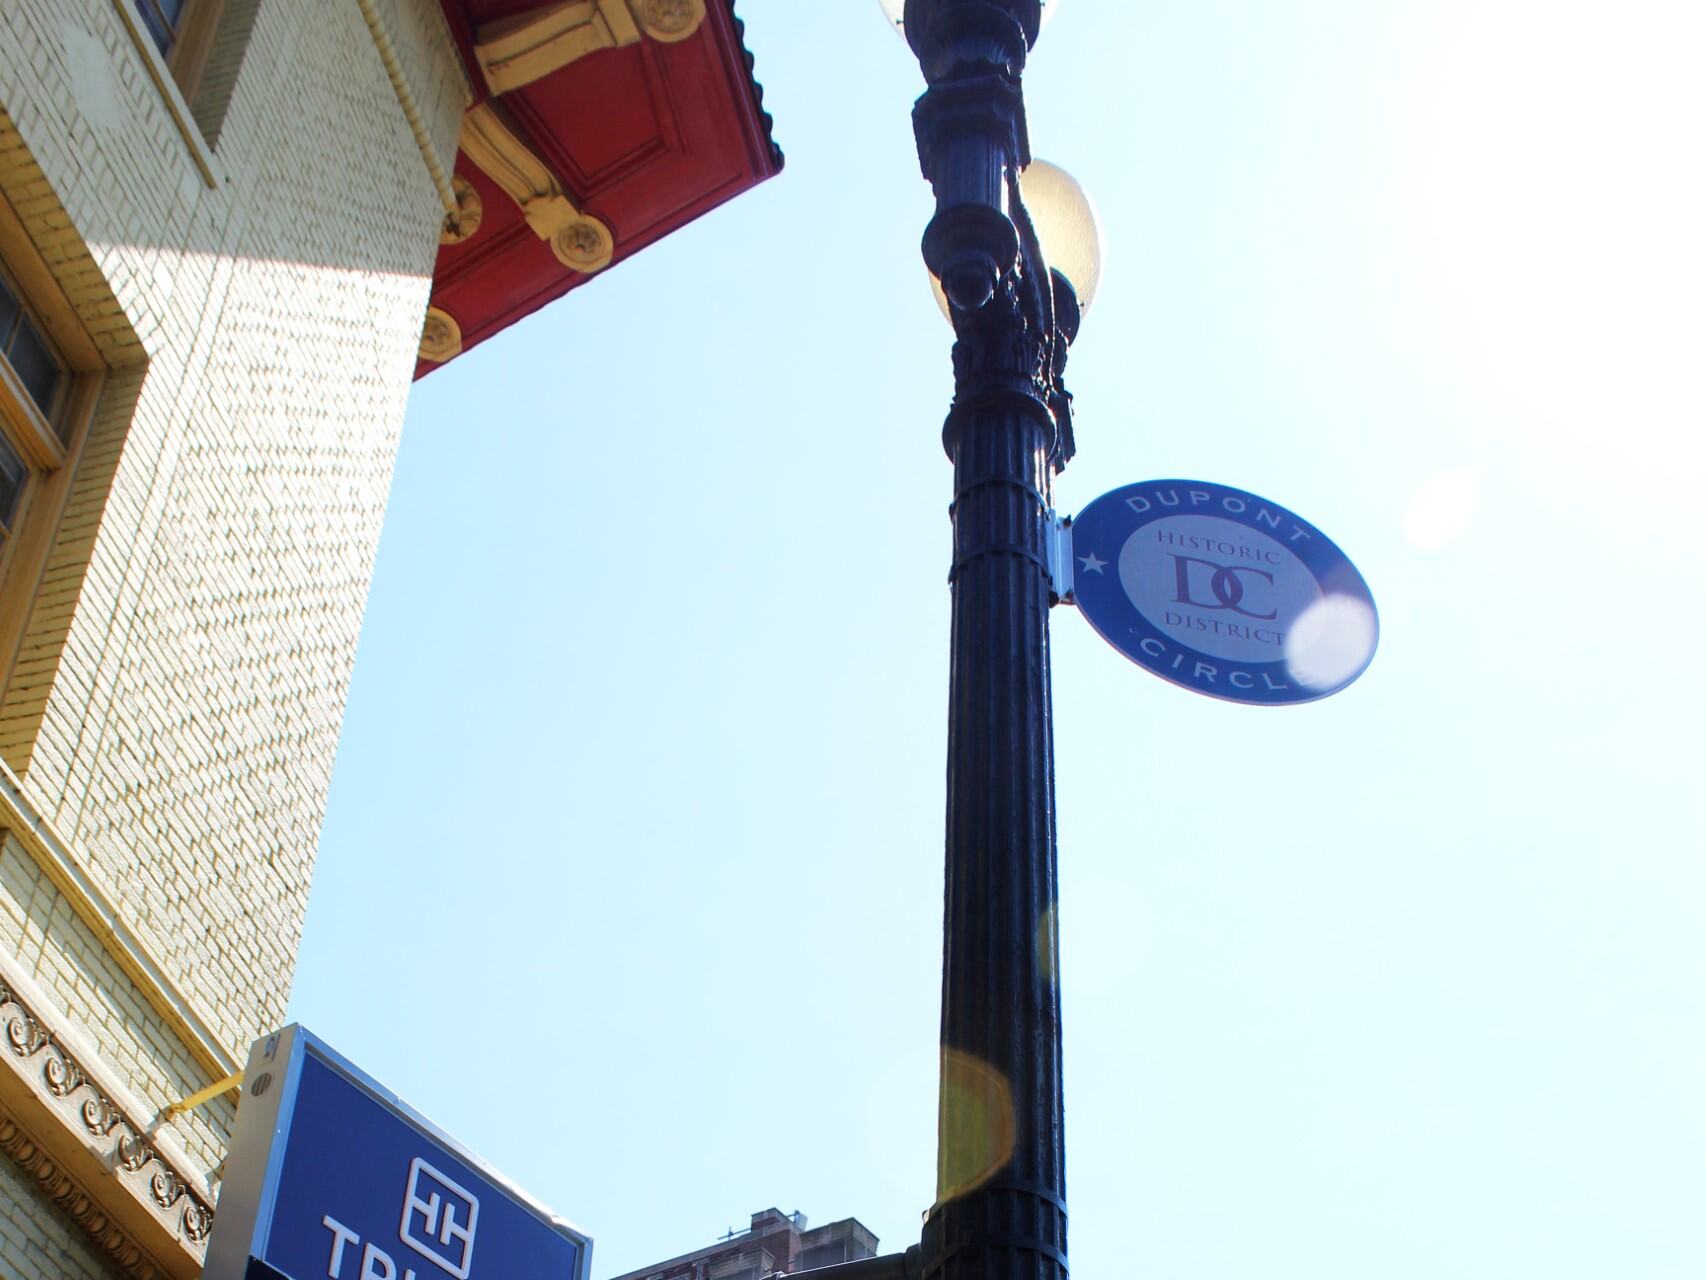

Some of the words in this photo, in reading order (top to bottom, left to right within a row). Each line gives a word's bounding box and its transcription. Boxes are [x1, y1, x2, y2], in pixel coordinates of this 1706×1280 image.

[1125, 490, 1311, 541] DUPONT
[1156, 529, 1282, 565] HISTORIC
[1166, 552, 1278, 621] DC
[1164, 611, 1286, 647] DISTRICT
[1140, 637, 1306, 691] CIRCL
